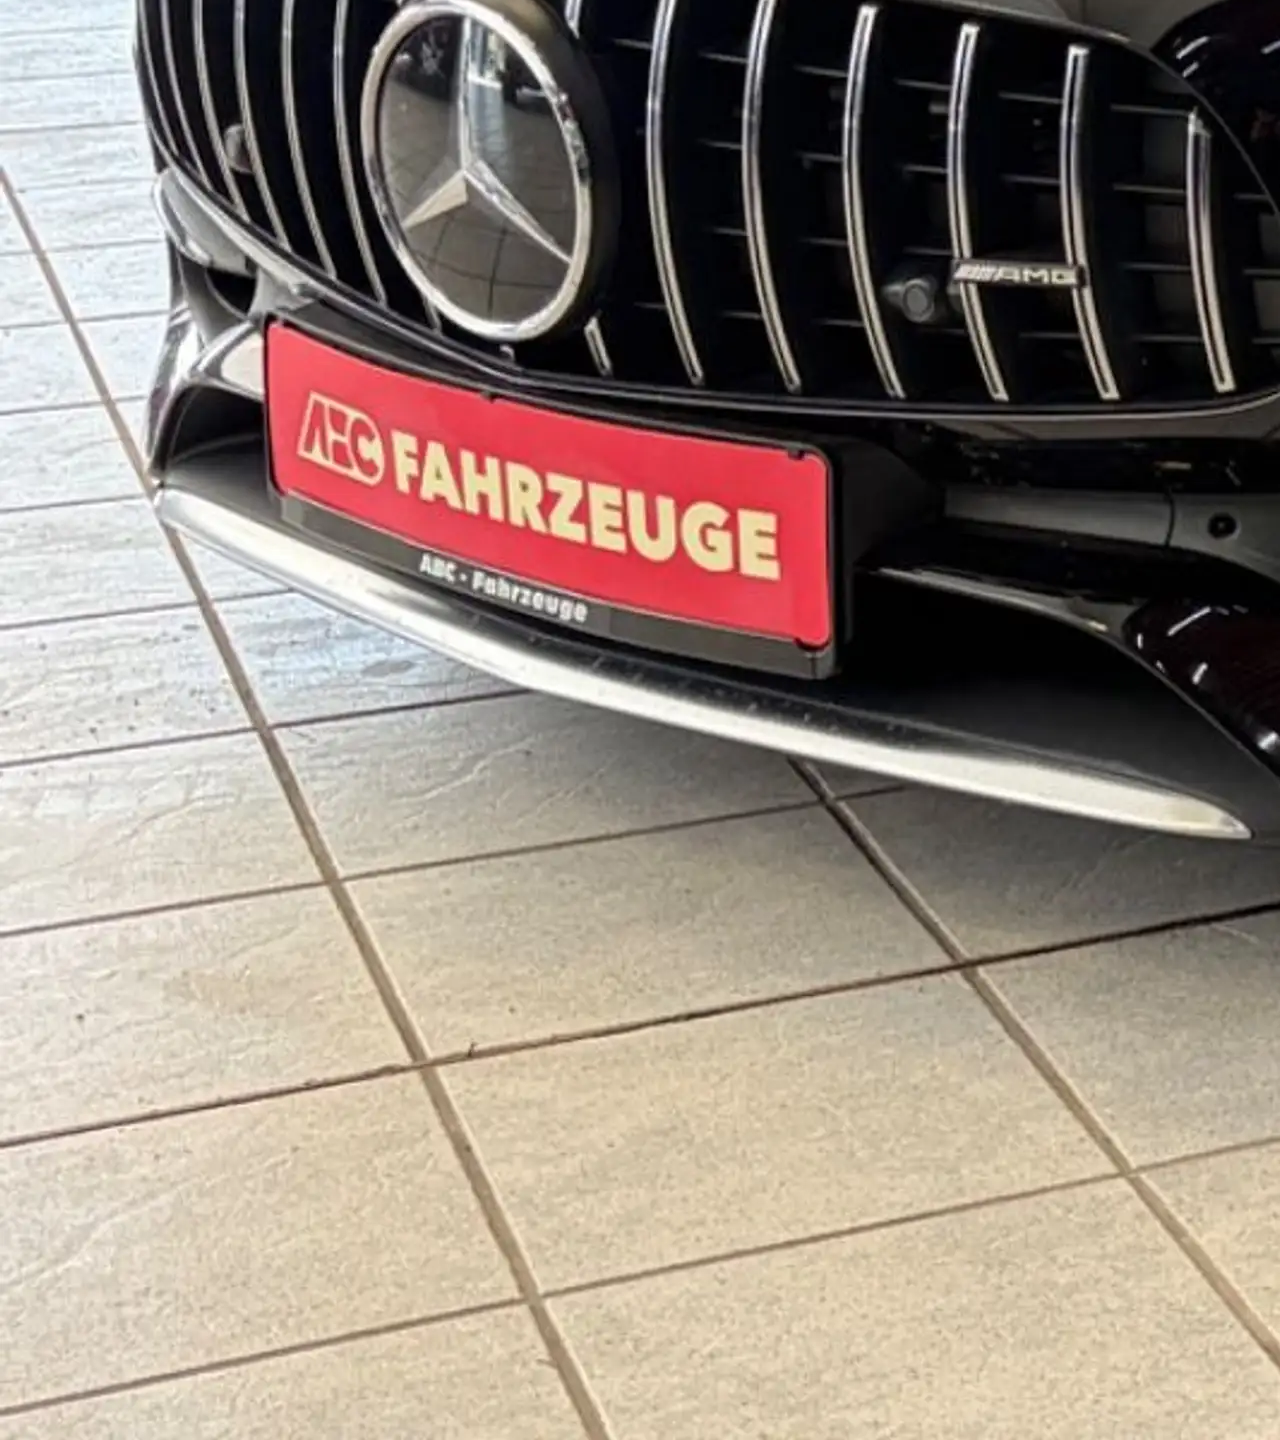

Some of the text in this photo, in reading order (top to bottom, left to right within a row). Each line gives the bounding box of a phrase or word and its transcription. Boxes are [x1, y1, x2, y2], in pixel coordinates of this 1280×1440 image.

[990, 265, 1078, 284] AMG
[391, 429, 781, 581] FAHRZEUGE
[419, 552, 588, 623] ABC Fahrzeuge
